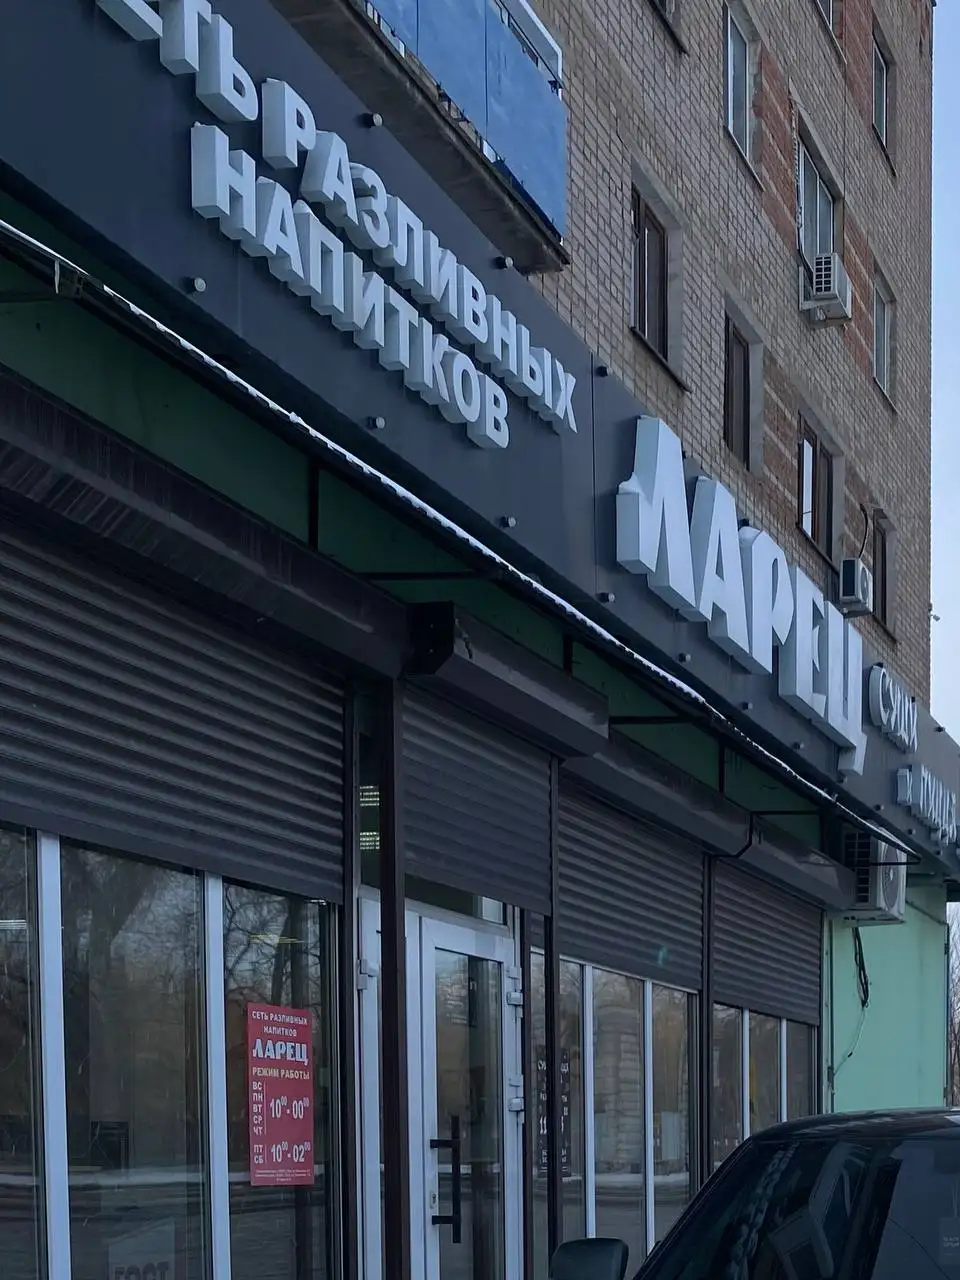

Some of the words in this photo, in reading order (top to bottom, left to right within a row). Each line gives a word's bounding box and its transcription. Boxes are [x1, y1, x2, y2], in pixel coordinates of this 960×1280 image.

[96, 0, 258, 123] ТЬ
[262, 78, 577, 433] РАЗЛИВНЫХ
[191, 122, 509, 449] НАПИТКОВ
[616, 415, 867, 776] ЛАРЕЦ
[252, 1011, 269, 1020] СЕТЬ
[270, 1013, 308, 1025] РАЗЛИВНЫХ
[263, 1026, 297, 1037] НАПИТКОВ
[252, 1038, 309, 1066] ЛАРЕЦ
[252, 1067, 280, 1077] РЕЖИМ
[280, 1069, 310, 1080] РАБОТЫ
[252, 1081, 263, 1090] ВС
[252, 1092, 263, 1102] ПН
[252, 1104, 263, 1113] ВТ
[253, 1115, 263, 1124] СР
[253, 1126, 263, 1135] ЧТ
[253, 1144, 263, 1153] ПТ
[254, 1155, 264, 1164] СБ
